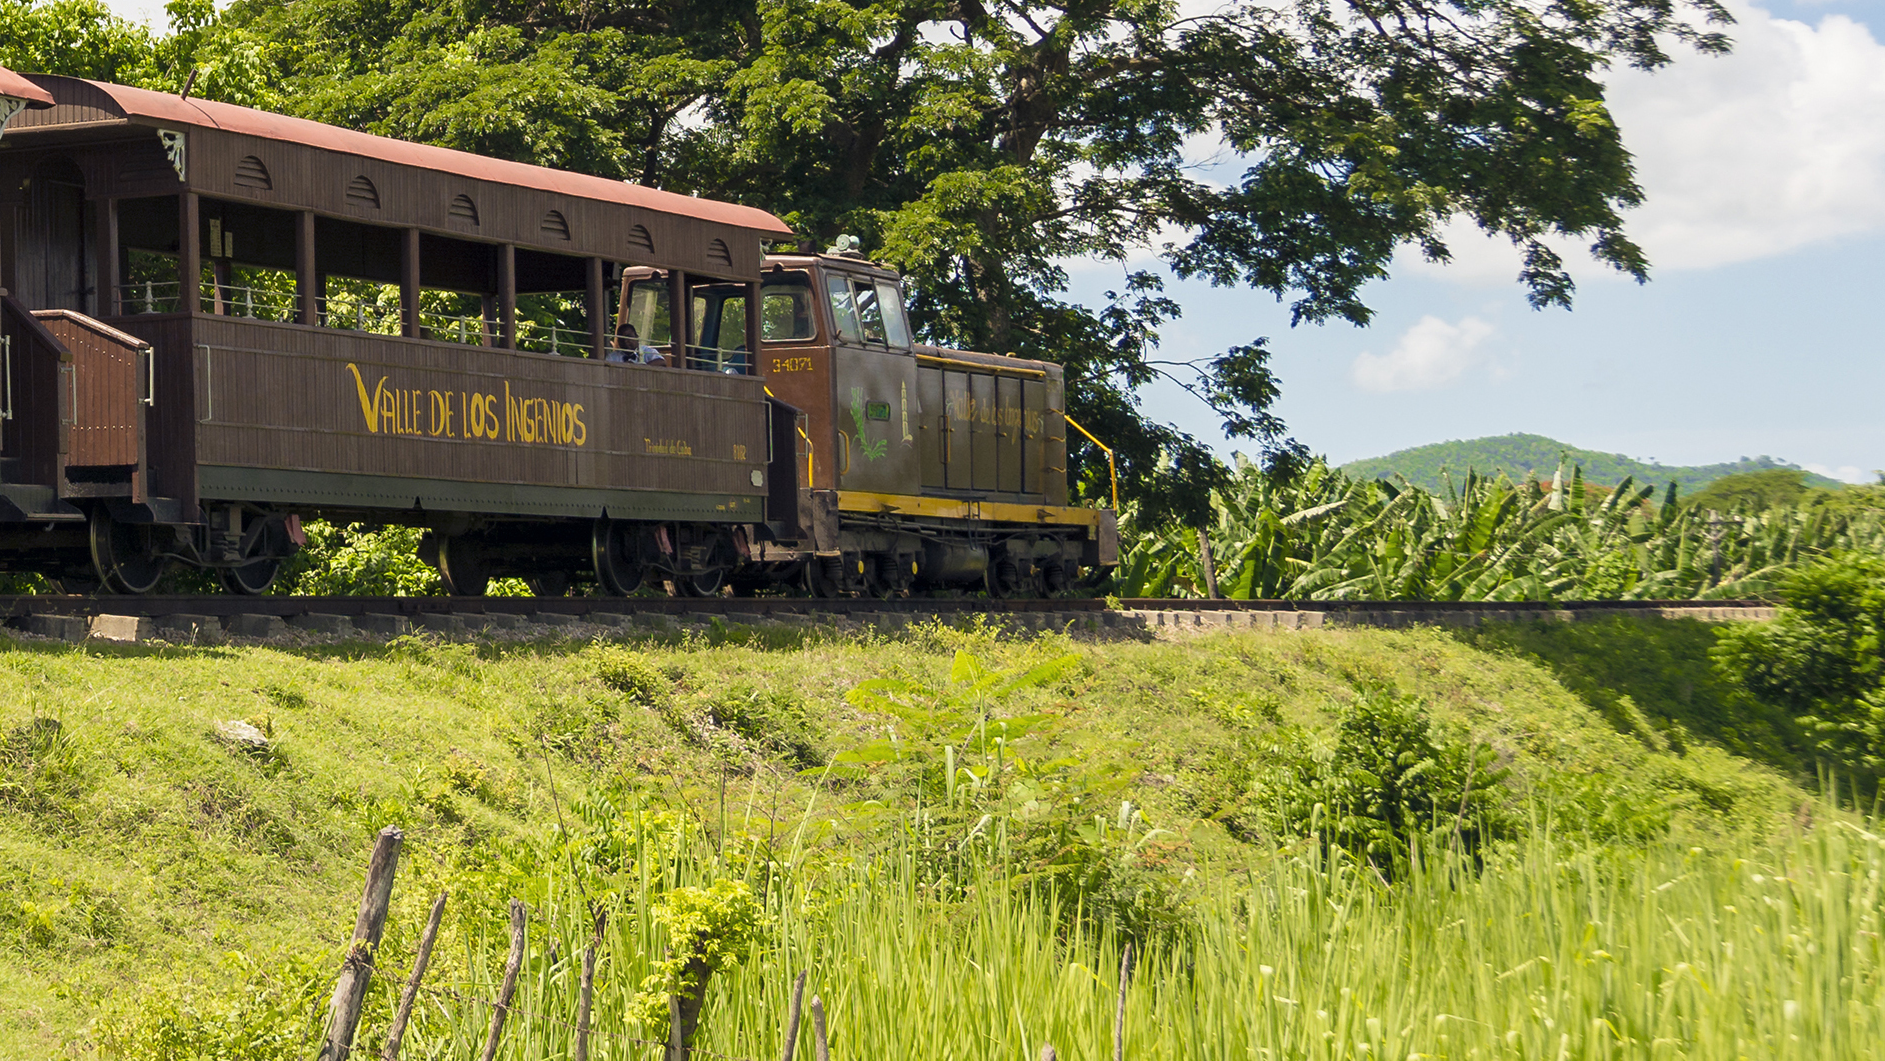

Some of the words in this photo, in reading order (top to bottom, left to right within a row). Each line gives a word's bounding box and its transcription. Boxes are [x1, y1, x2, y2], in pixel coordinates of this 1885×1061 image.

[346, 362, 422, 435] VALLE
[427, 389, 455, 438] DE
[462, 391, 499, 440] LOS
[504, 380, 586, 446] INGENIOS
